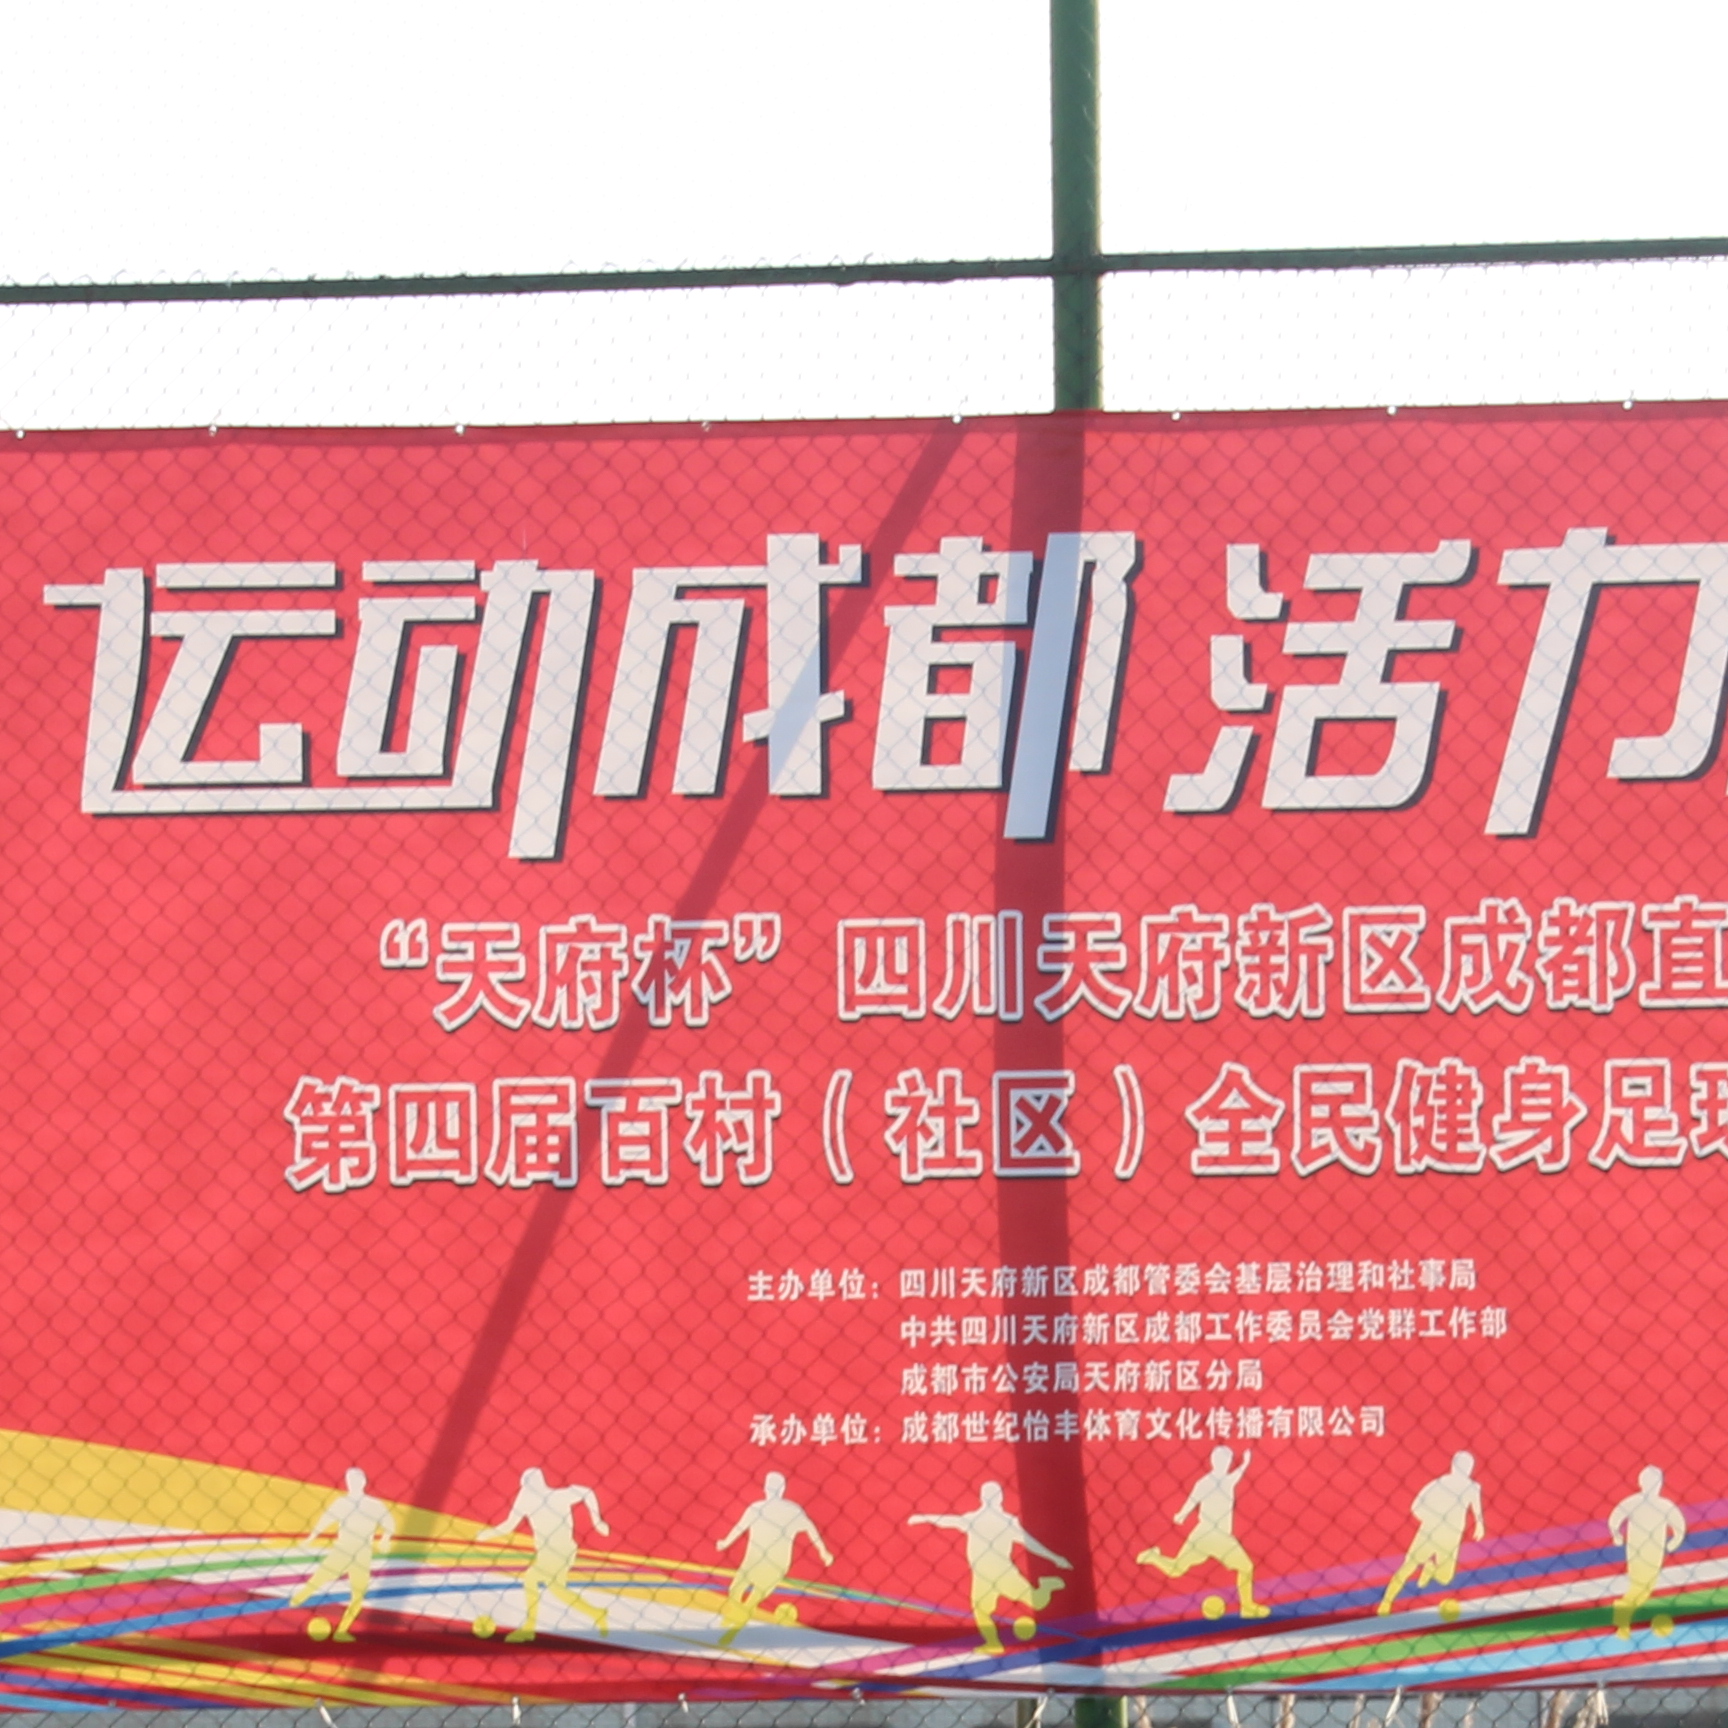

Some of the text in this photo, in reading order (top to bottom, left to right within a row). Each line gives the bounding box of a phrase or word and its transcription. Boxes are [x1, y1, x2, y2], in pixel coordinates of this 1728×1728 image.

[41, 529, 1135, 860] 运动成都
[379, 912, 781, 1031] “天府杯”
[901, 1306, 1507, 1348] 中共四川天府新区成都工作委员会党群工作部
[901, 1359, 1263, 1396] 成都市公安局天府新区分局
